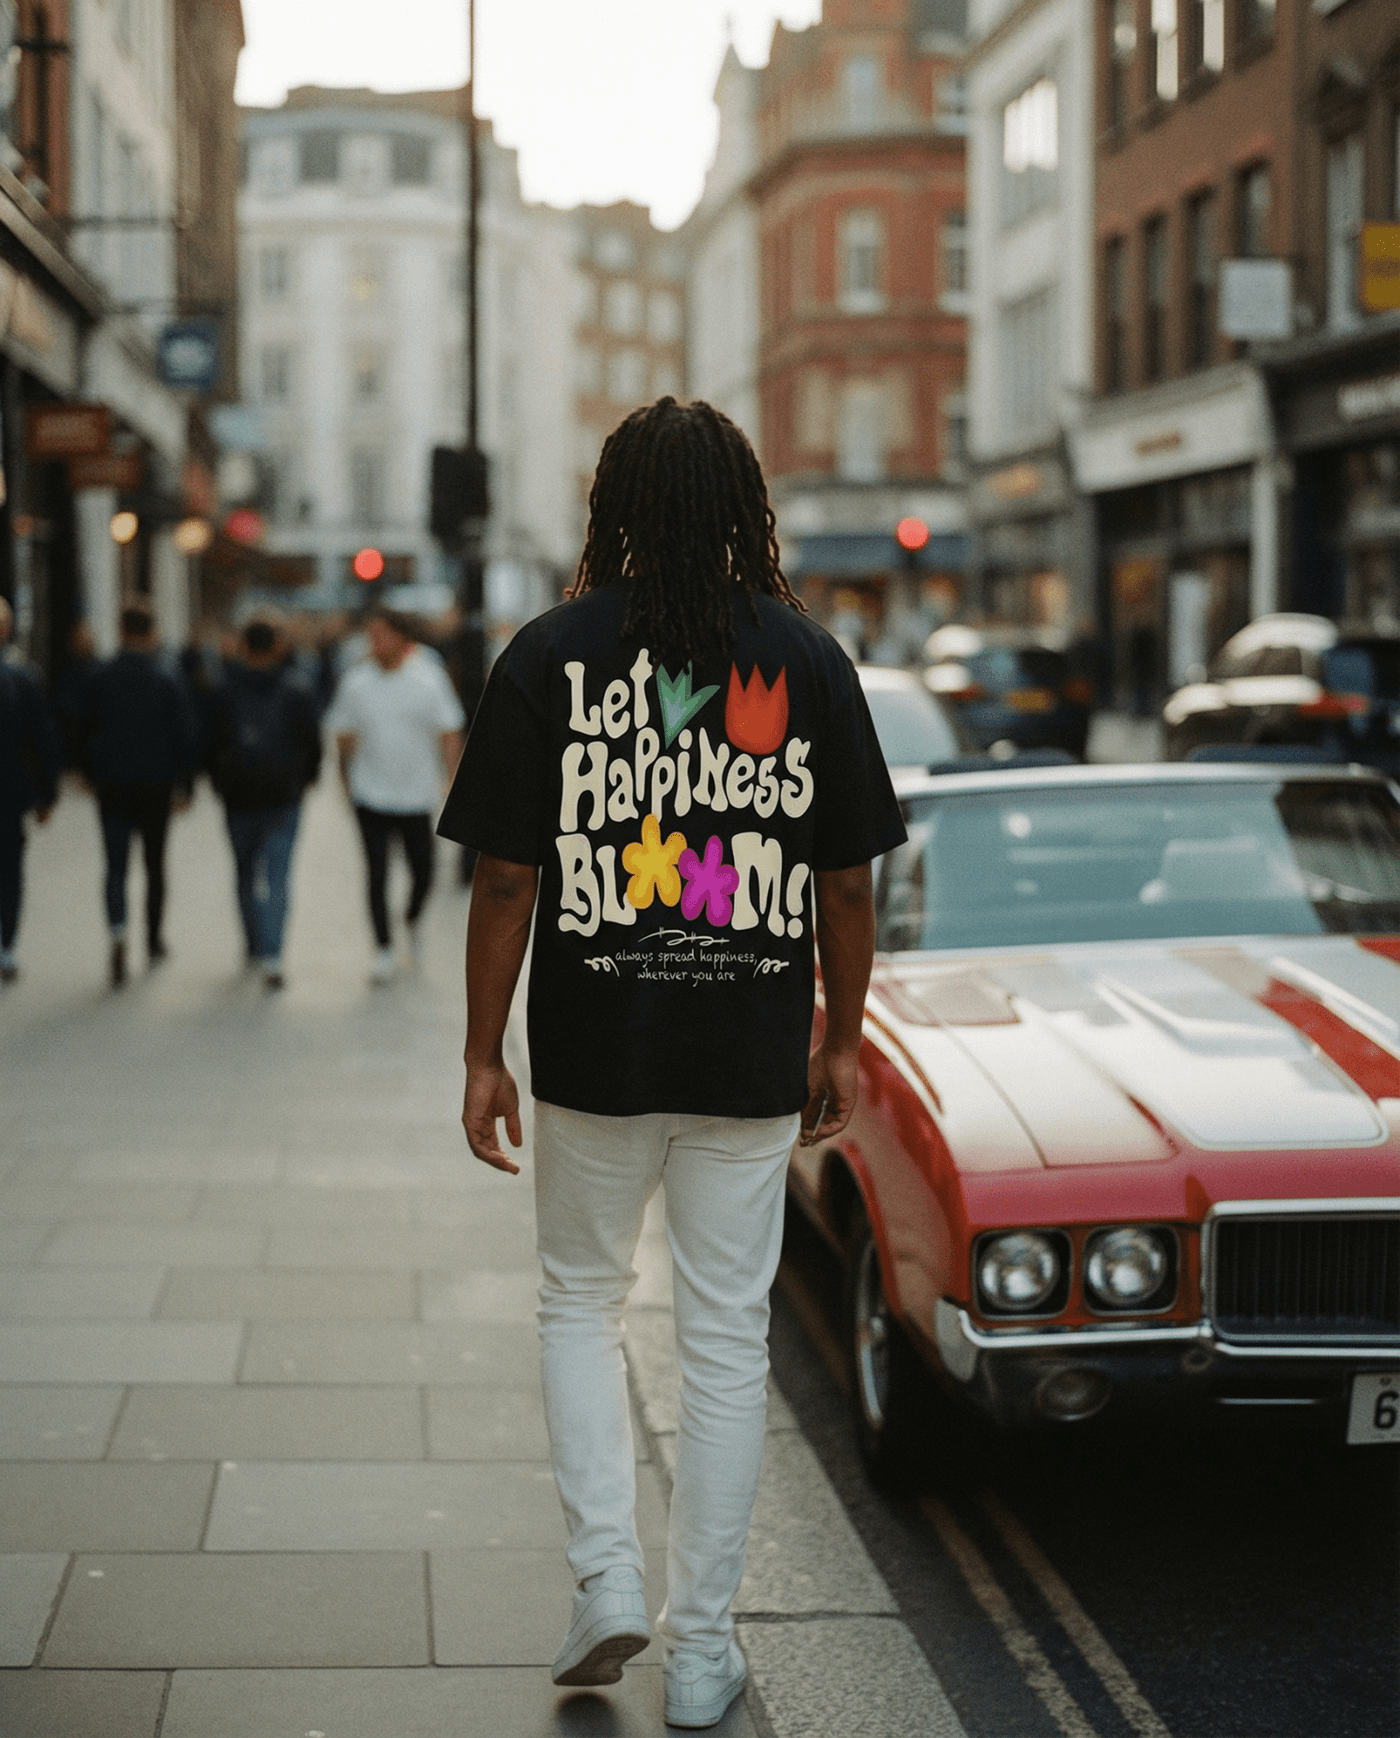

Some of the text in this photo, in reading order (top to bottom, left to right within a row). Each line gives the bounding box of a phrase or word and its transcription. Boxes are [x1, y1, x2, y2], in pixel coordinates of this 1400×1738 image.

[564, 648, 653, 739] Let
[615, 948, 758, 970] always spread happiness,
[637, 967, 736, 988] wherever you are
[1373, 1390, 1400, 1431] 6
